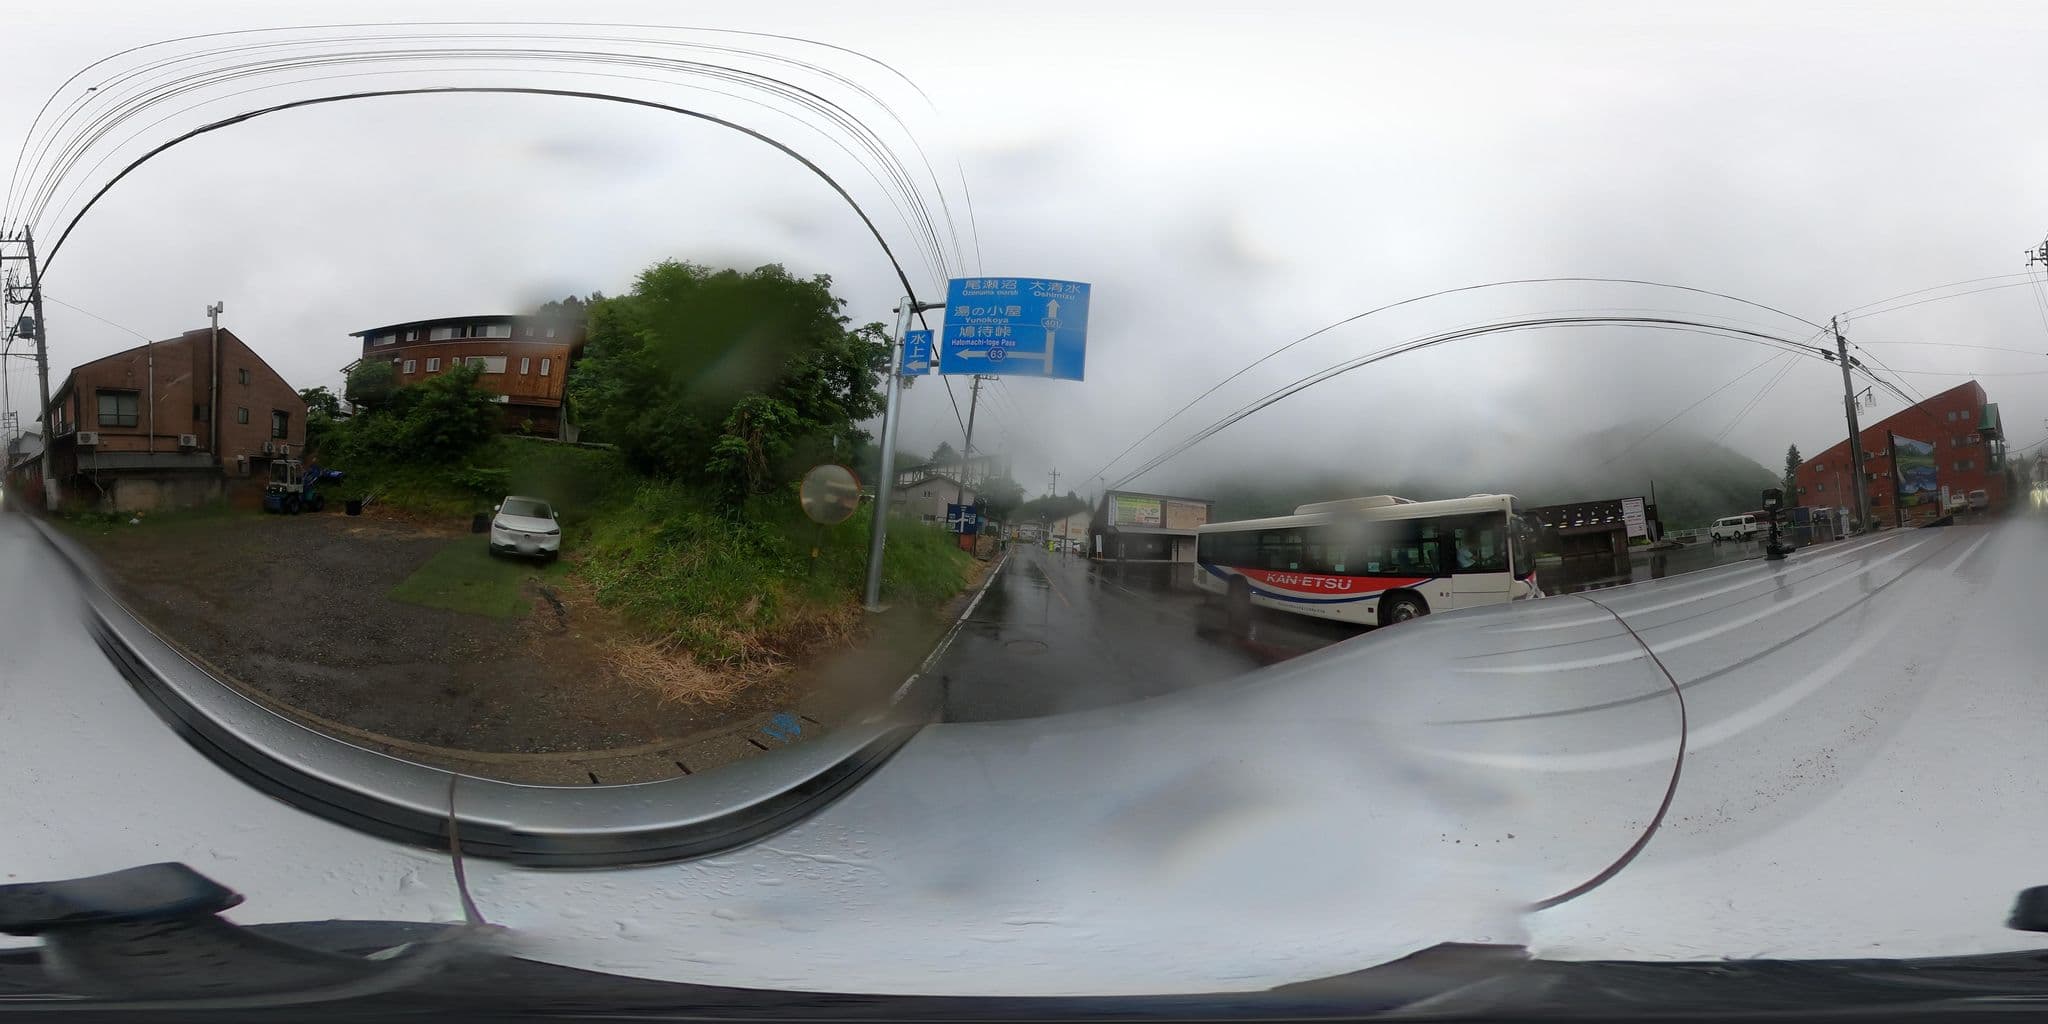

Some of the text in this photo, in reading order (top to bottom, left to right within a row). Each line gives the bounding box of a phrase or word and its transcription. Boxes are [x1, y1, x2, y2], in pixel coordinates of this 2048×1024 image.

[964, 279, 1018, 290] 尾瀬沼
[1028, 280, 1081, 294] 大清水
[953, 305, 1022, 317] 湯の小屋
[965, 317, 1009, 325] Yunokoya
[959, 326, 1012, 338] 鳩待峠
[909, 333, 926, 359] 水上
[1001, 339, 1016, 347] Pass
[990, 349, 1003, 359] 63
[1266, 572, 1352, 590] KAN-ETSU
